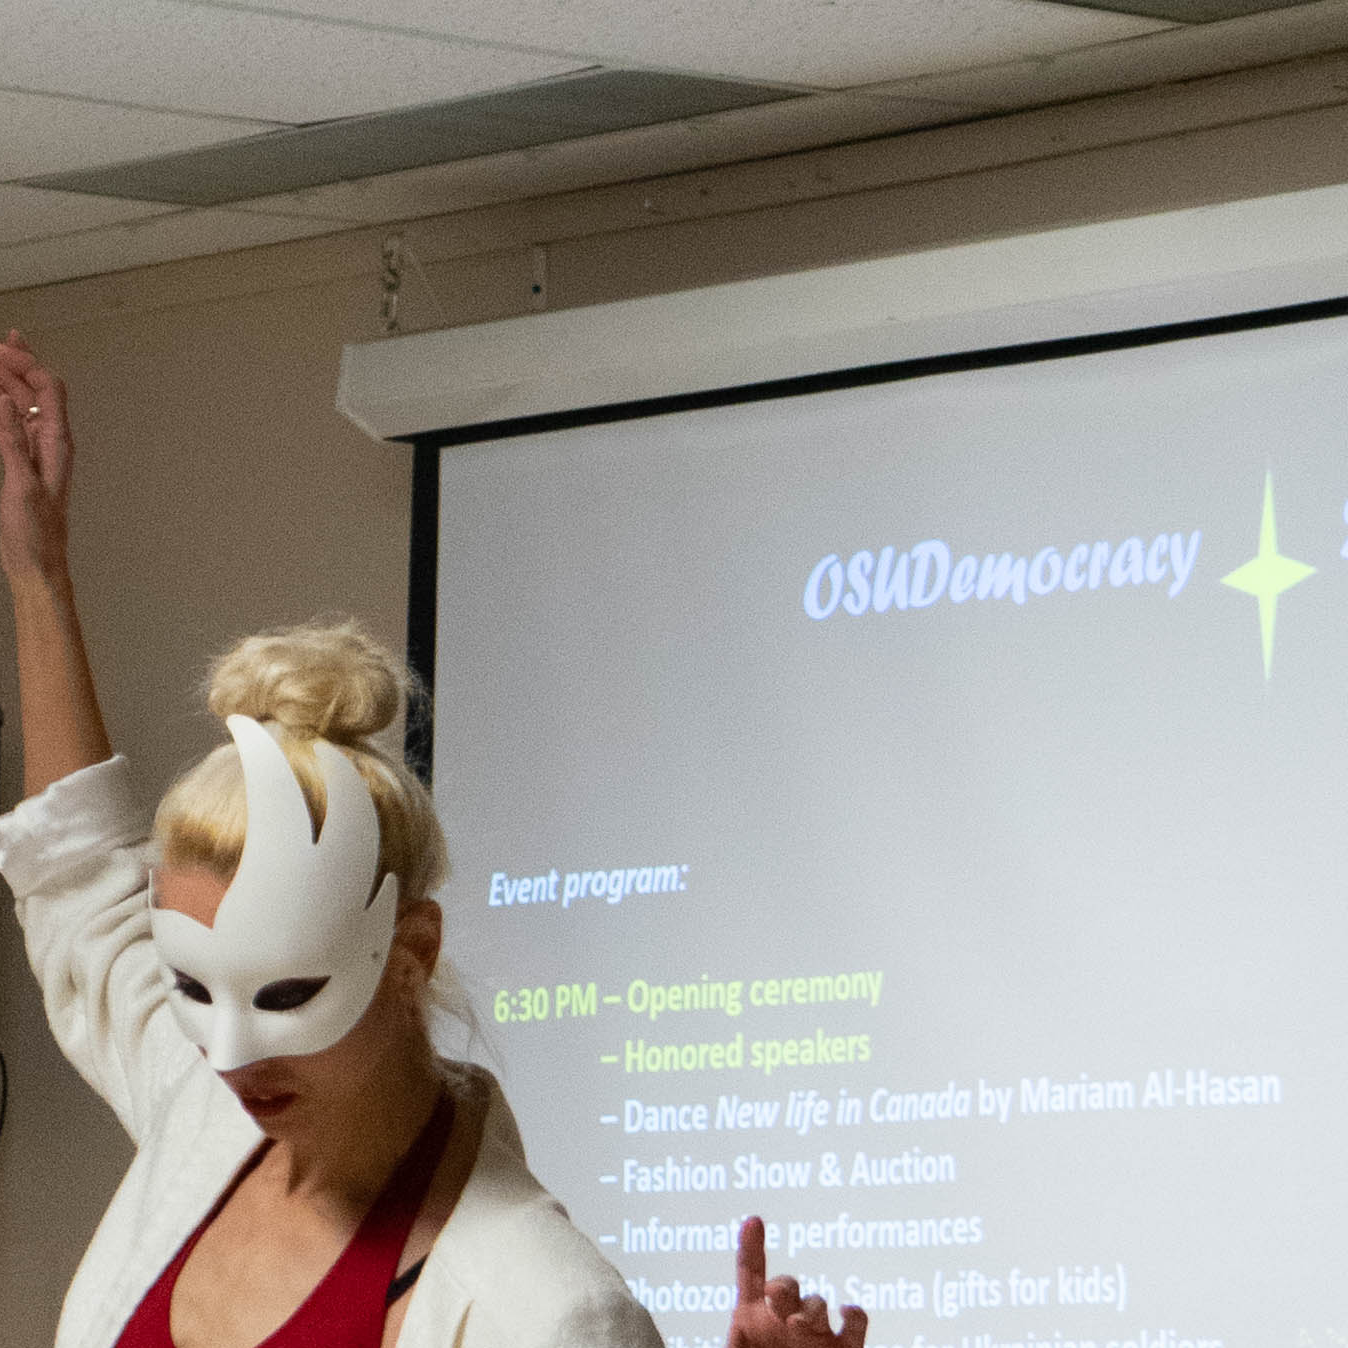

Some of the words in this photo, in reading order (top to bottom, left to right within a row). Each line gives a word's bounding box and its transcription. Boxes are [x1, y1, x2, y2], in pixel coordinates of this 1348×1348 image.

[803, 530, 1202, 621] OSUDemocracy
[488, 867, 559, 907] Event
[563, 864, 690, 908] program:
[493, 986, 550, 1024] 6:30
[556, 981, 598, 1019] PM
[627, 973, 743, 1021] Opening
[749, 970, 884, 1008] ceremony
[624, 1032, 743, 1073] Honored
[750, 1028, 872, 1075] speakers
[624, 1099, 708, 1133] Dance
[715, 1096, 780, 1129] New
[785, 1089, 830, 1136] life
[836, 1089, 863, 1126] in
[869, 1081, 972, 1122] Canada
[977, 1078, 1014, 1124] by
[1020, 1072, 1135, 1114] Mariam
[1142, 1069, 1282, 1108] Al-Hasan
[624, 1156, 728, 1193] Fashion
[733, 1153, 811, 1190] Show
[818, 1152, 843, 1188] &
[850, 1147, 956, 1187] Auction
[623, 1215, 781, 1252] Informate
[787, 1213, 984, 1258] performances
[799, 1274, 836, 1310] ith
[845, 1274, 925, 1311] Santa
[933, 1268, 1001, 1319] (gifts
[1008, 1267, 1051, 1306] for
[1057, 1261, 1128, 1312] kids)
